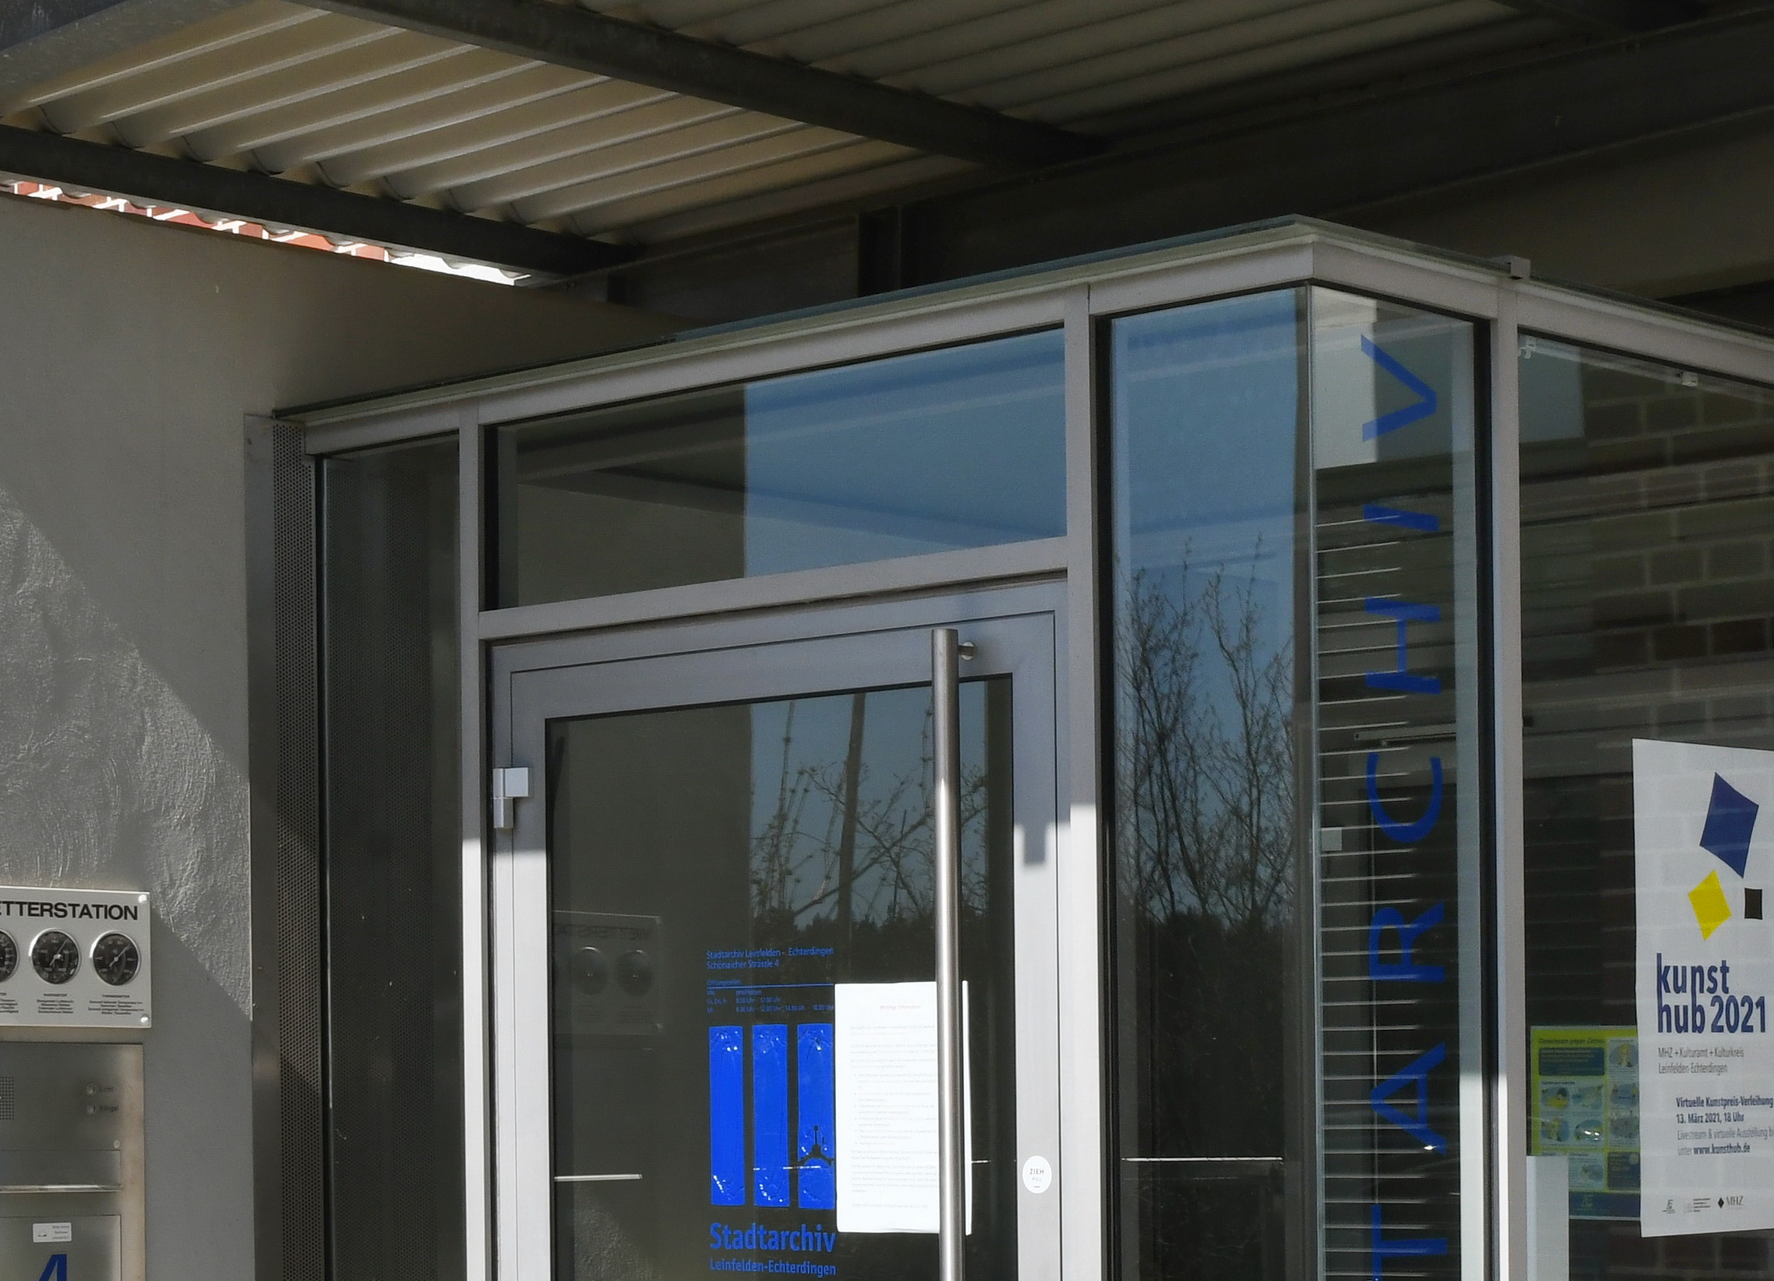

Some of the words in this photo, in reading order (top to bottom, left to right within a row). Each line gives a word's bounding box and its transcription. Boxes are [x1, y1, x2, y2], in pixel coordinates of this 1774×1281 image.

[706, 950, 744, 960] Stadtarchiv
[787, 946, 834, 957] Echterdingen
[1656, 952, 1730, 994] kunst
[1656, 993, 1706, 1034] hub
[1709, 994, 1766, 1034] 2021
[1675, 1096, 1704, 1107] Virtuelle
[1705, 1095, 1774, 1109] Kunstpreis-Verleihung
[1676, 1112, 1687, 1124] 13.
[1687, 1112, 1704, 1124] März
[1704, 1112, 1723, 1124] 2021,
[1723, 1111, 1732, 1123] 18
[1732, 1110, 1745, 1122] Uhr
[1736, 1127, 1768, 1141] Ausstellung
[1693, 1142, 1751, 1155] www.kunsthub.de
[1725, 1195, 1744, 1206] MHZ
[709, 1221, 837, 1253] Stadtarchiv
[709, 1258, 837, 1279] Leinfelden-Echterdingen
